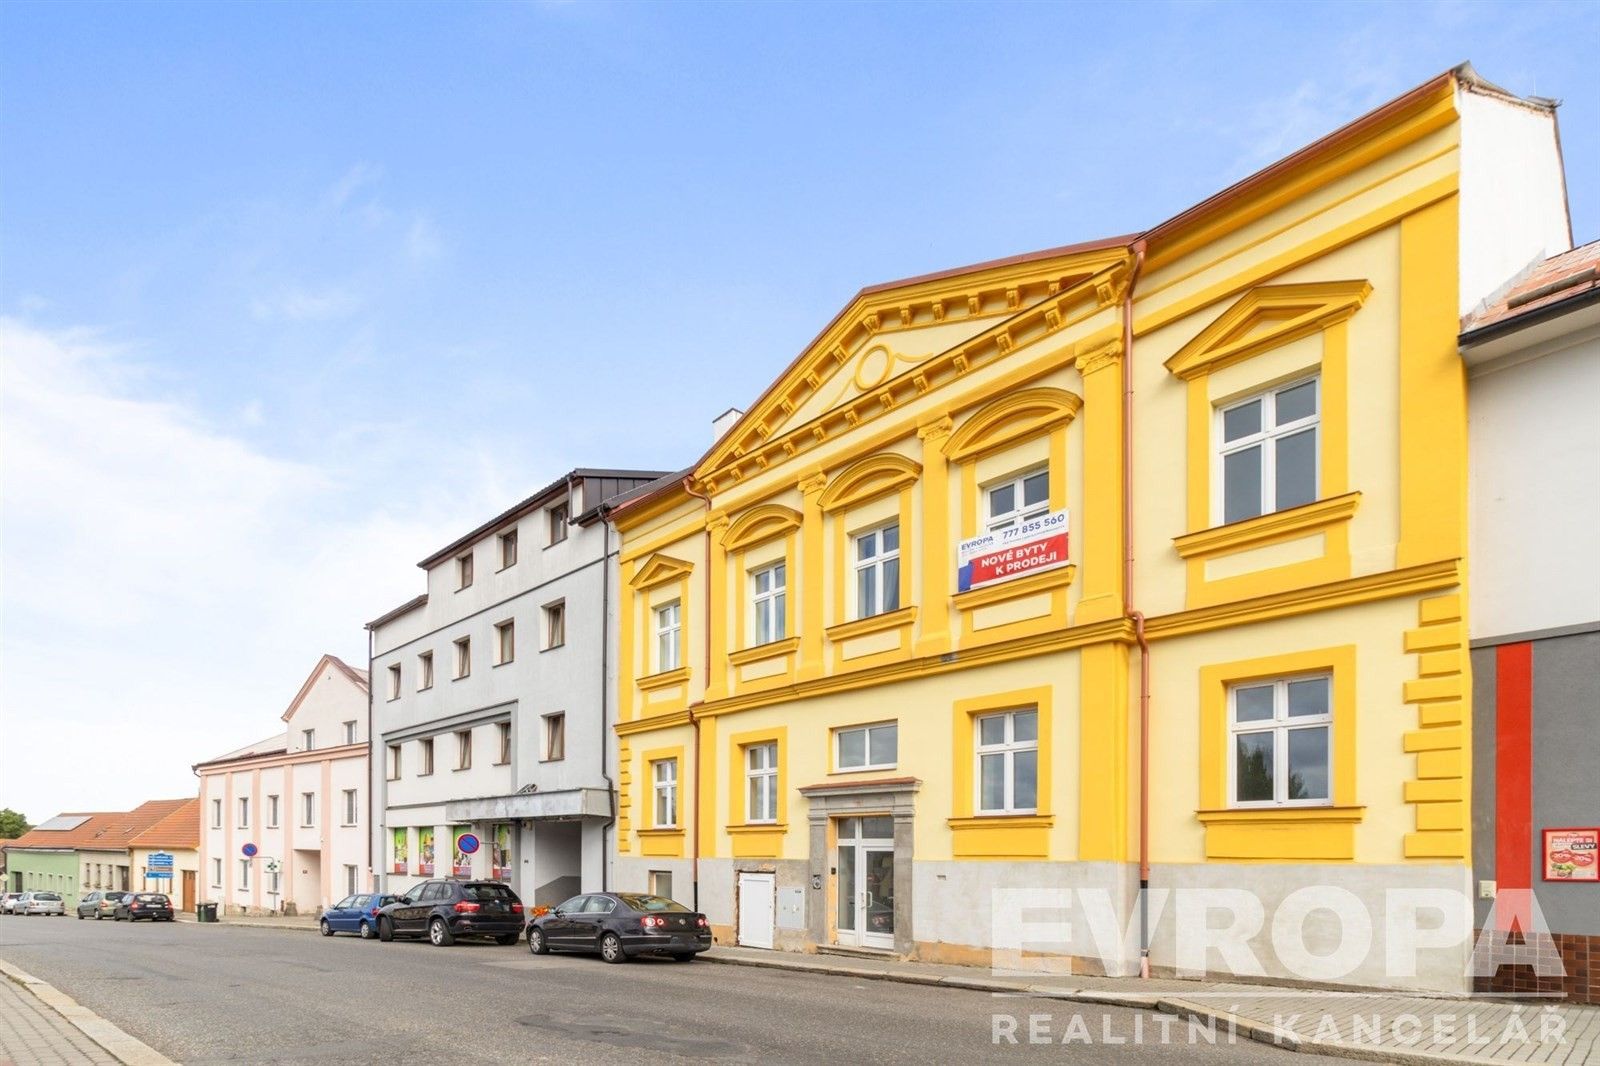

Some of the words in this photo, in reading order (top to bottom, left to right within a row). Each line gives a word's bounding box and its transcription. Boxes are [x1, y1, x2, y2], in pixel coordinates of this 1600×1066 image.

[1003, 527, 1019, 539] 777
[1022, 521, 1041, 534] 855
[1044, 513, 1065, 527] 560
[961, 536, 994, 550] EVROPA
[981, 551, 1014, 568] NOVÉ
[1016, 542, 1048, 559] BYTY
[995, 566, 1004, 576] K
[1006, 551, 1057, 573] PRODEJI
